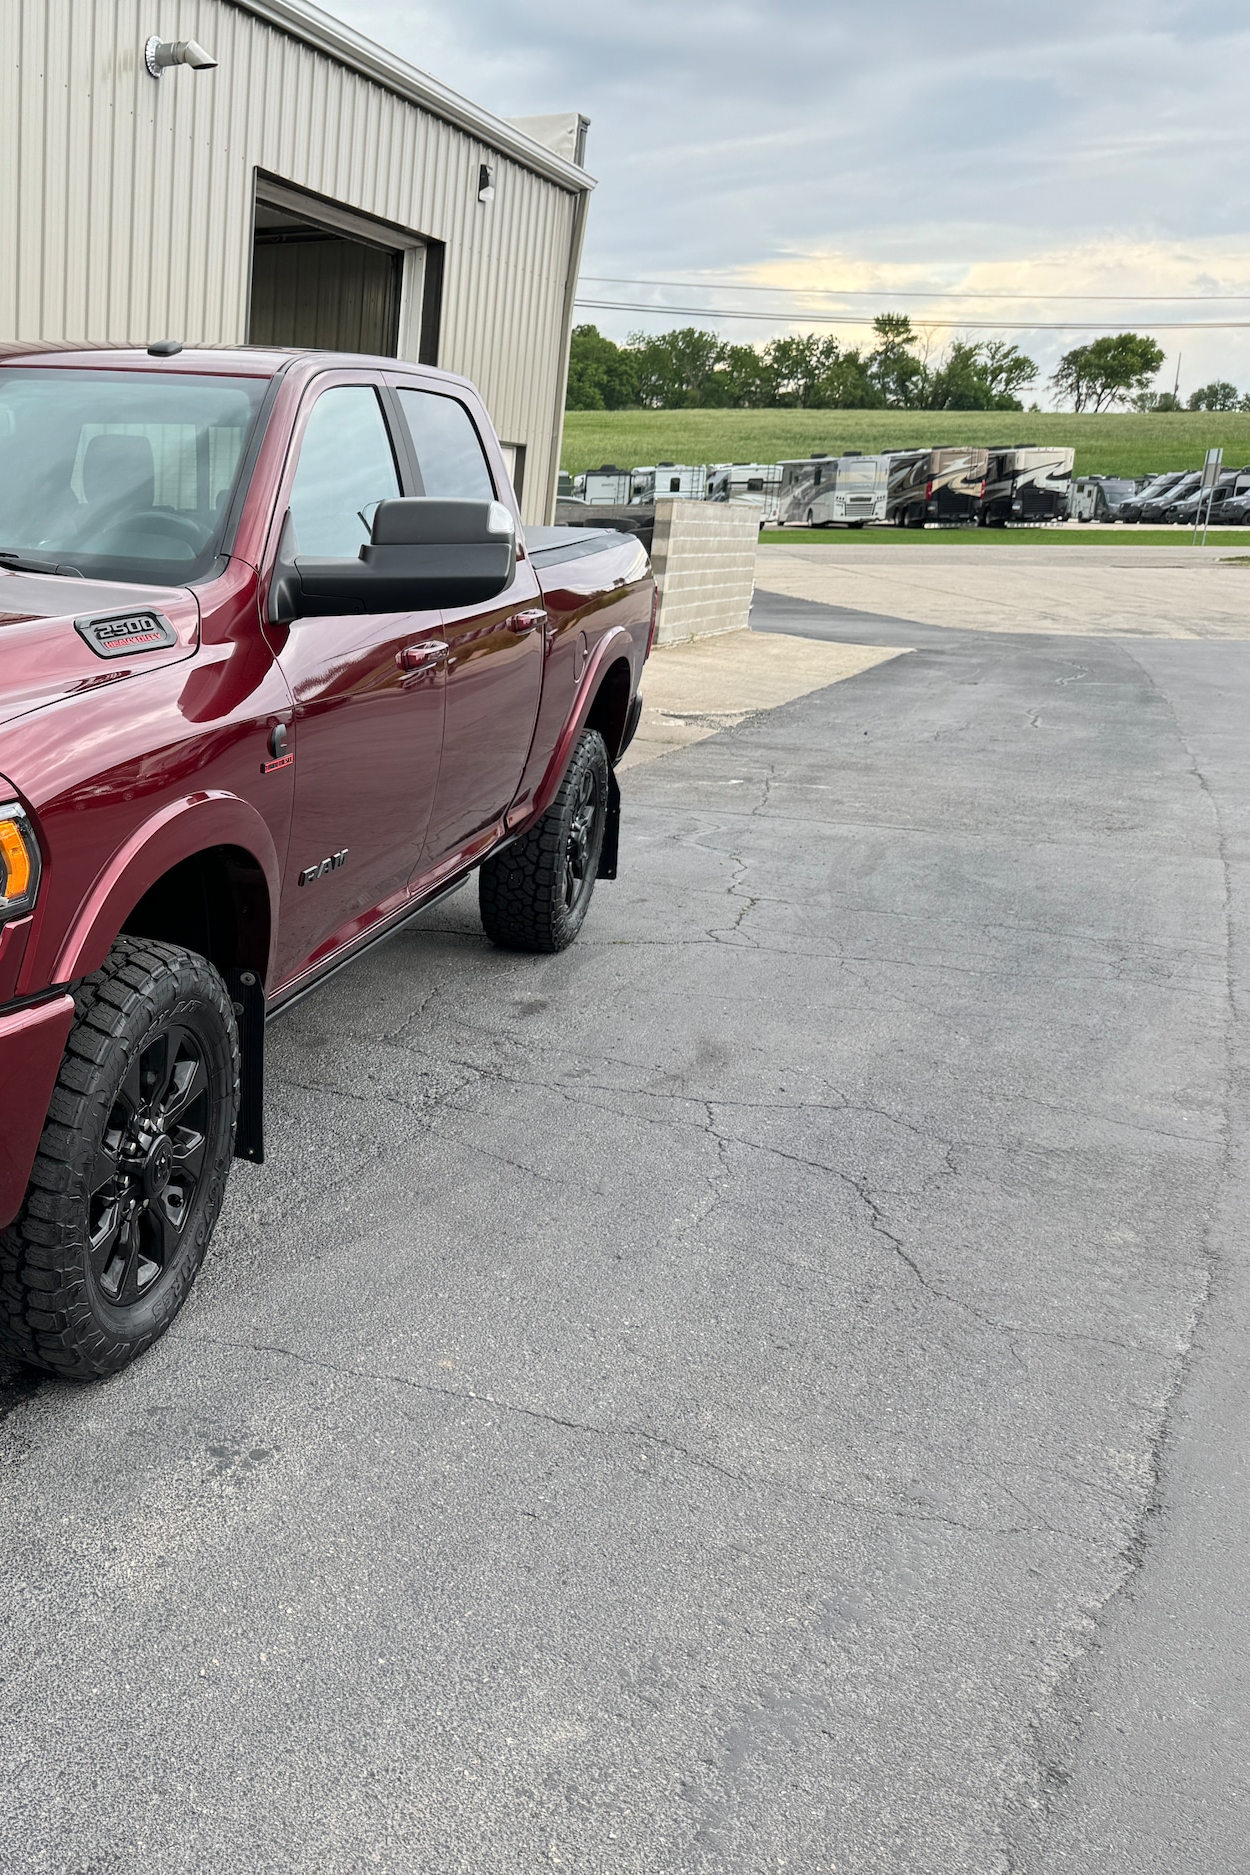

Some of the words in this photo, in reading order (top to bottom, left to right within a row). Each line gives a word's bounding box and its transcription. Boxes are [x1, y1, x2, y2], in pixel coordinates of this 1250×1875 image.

[94, 619, 155, 640] 2500
[104, 636, 138, 649] HEAVY
[136, 632, 161, 645] DUTY
